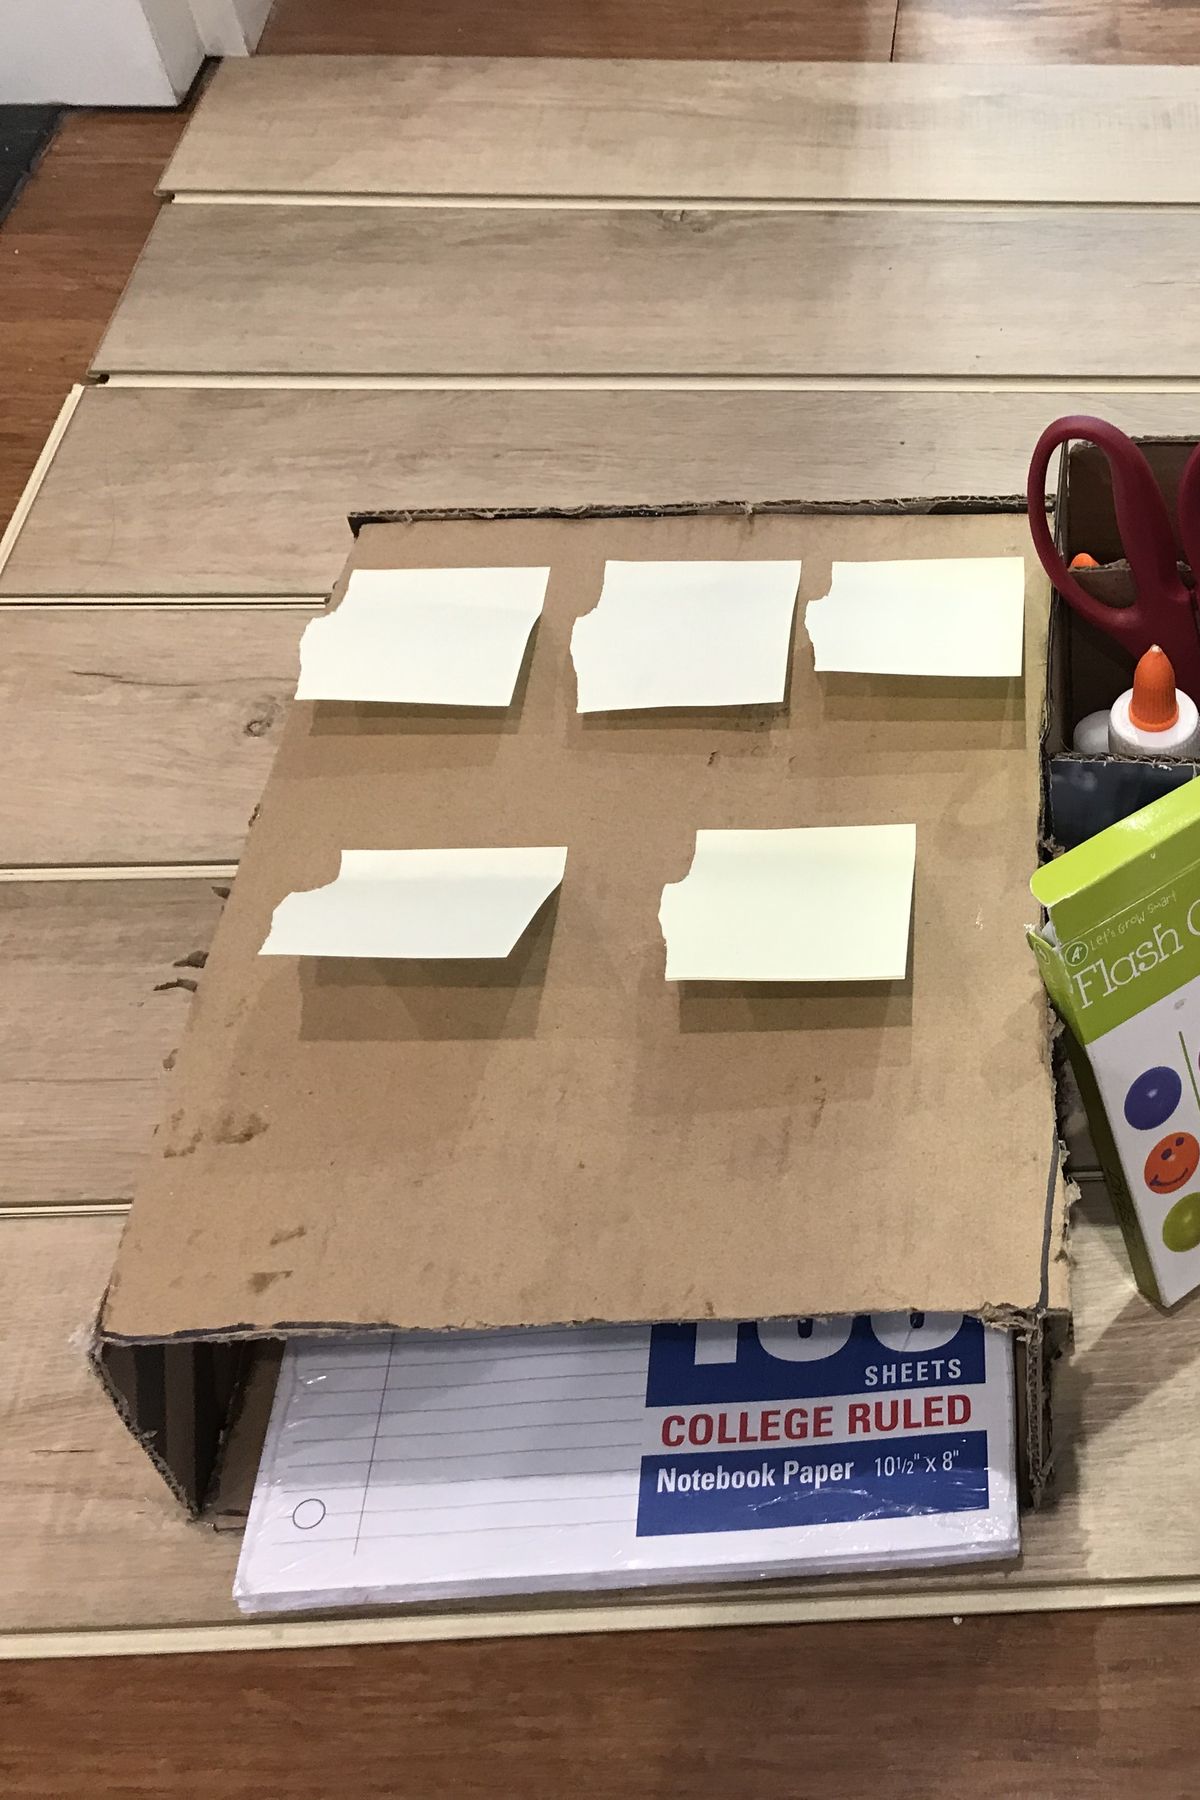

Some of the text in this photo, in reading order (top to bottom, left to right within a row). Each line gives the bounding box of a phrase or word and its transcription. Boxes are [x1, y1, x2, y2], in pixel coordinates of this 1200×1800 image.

[1118, 909, 1146, 935] Grow
[1072, 923, 1184, 1009] Flash
[864, 1358, 962, 1386] SHEETS
[661, 1394, 972, 1447] COLLEGE RULED
[656, 1460, 776, 1493] Notebook
[783, 1459, 855, 1490] Paper
